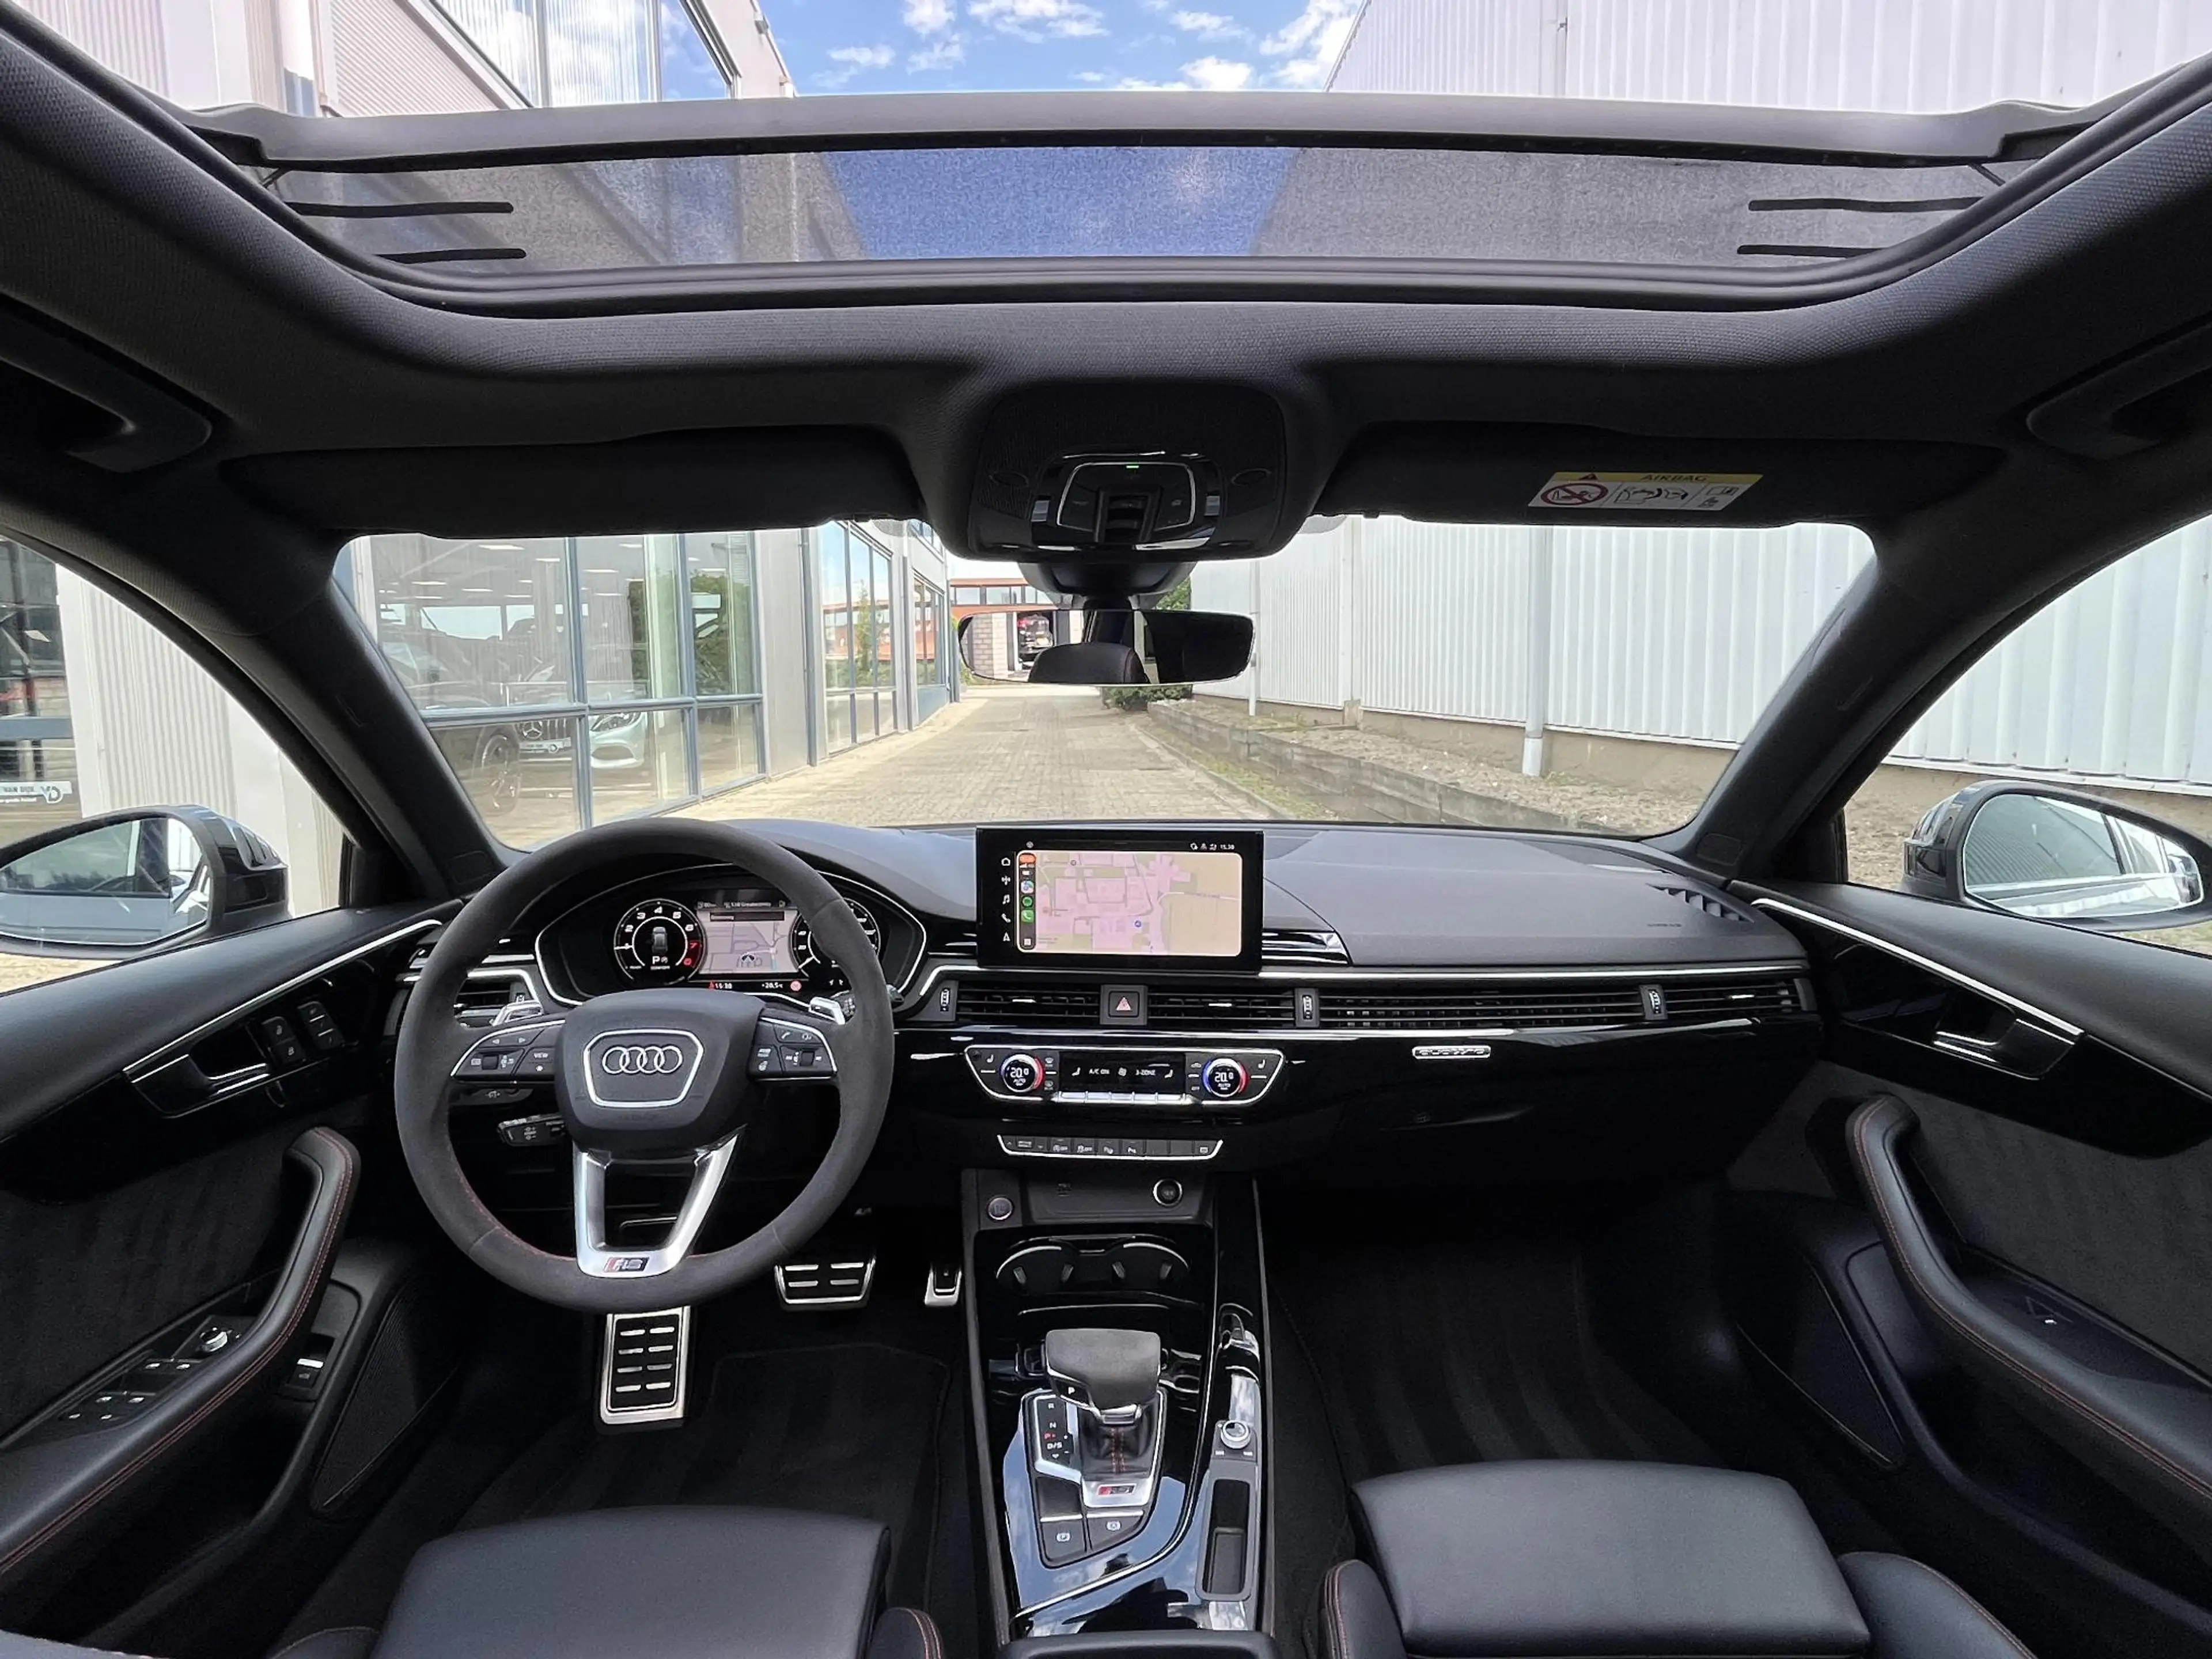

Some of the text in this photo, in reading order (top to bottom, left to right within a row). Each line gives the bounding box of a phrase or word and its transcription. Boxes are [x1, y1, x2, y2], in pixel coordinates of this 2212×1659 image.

[1640, 474, 1709, 482] AIRBAG
[653, 906, 663, 914] 4
[636, 912, 646, 920] 3
[624, 924, 634, 933] 2
[652, 956, 660, 964] P
[1068, 1387, 1075, 1395] P
[1047, 1442, 1063, 1450] D/S
